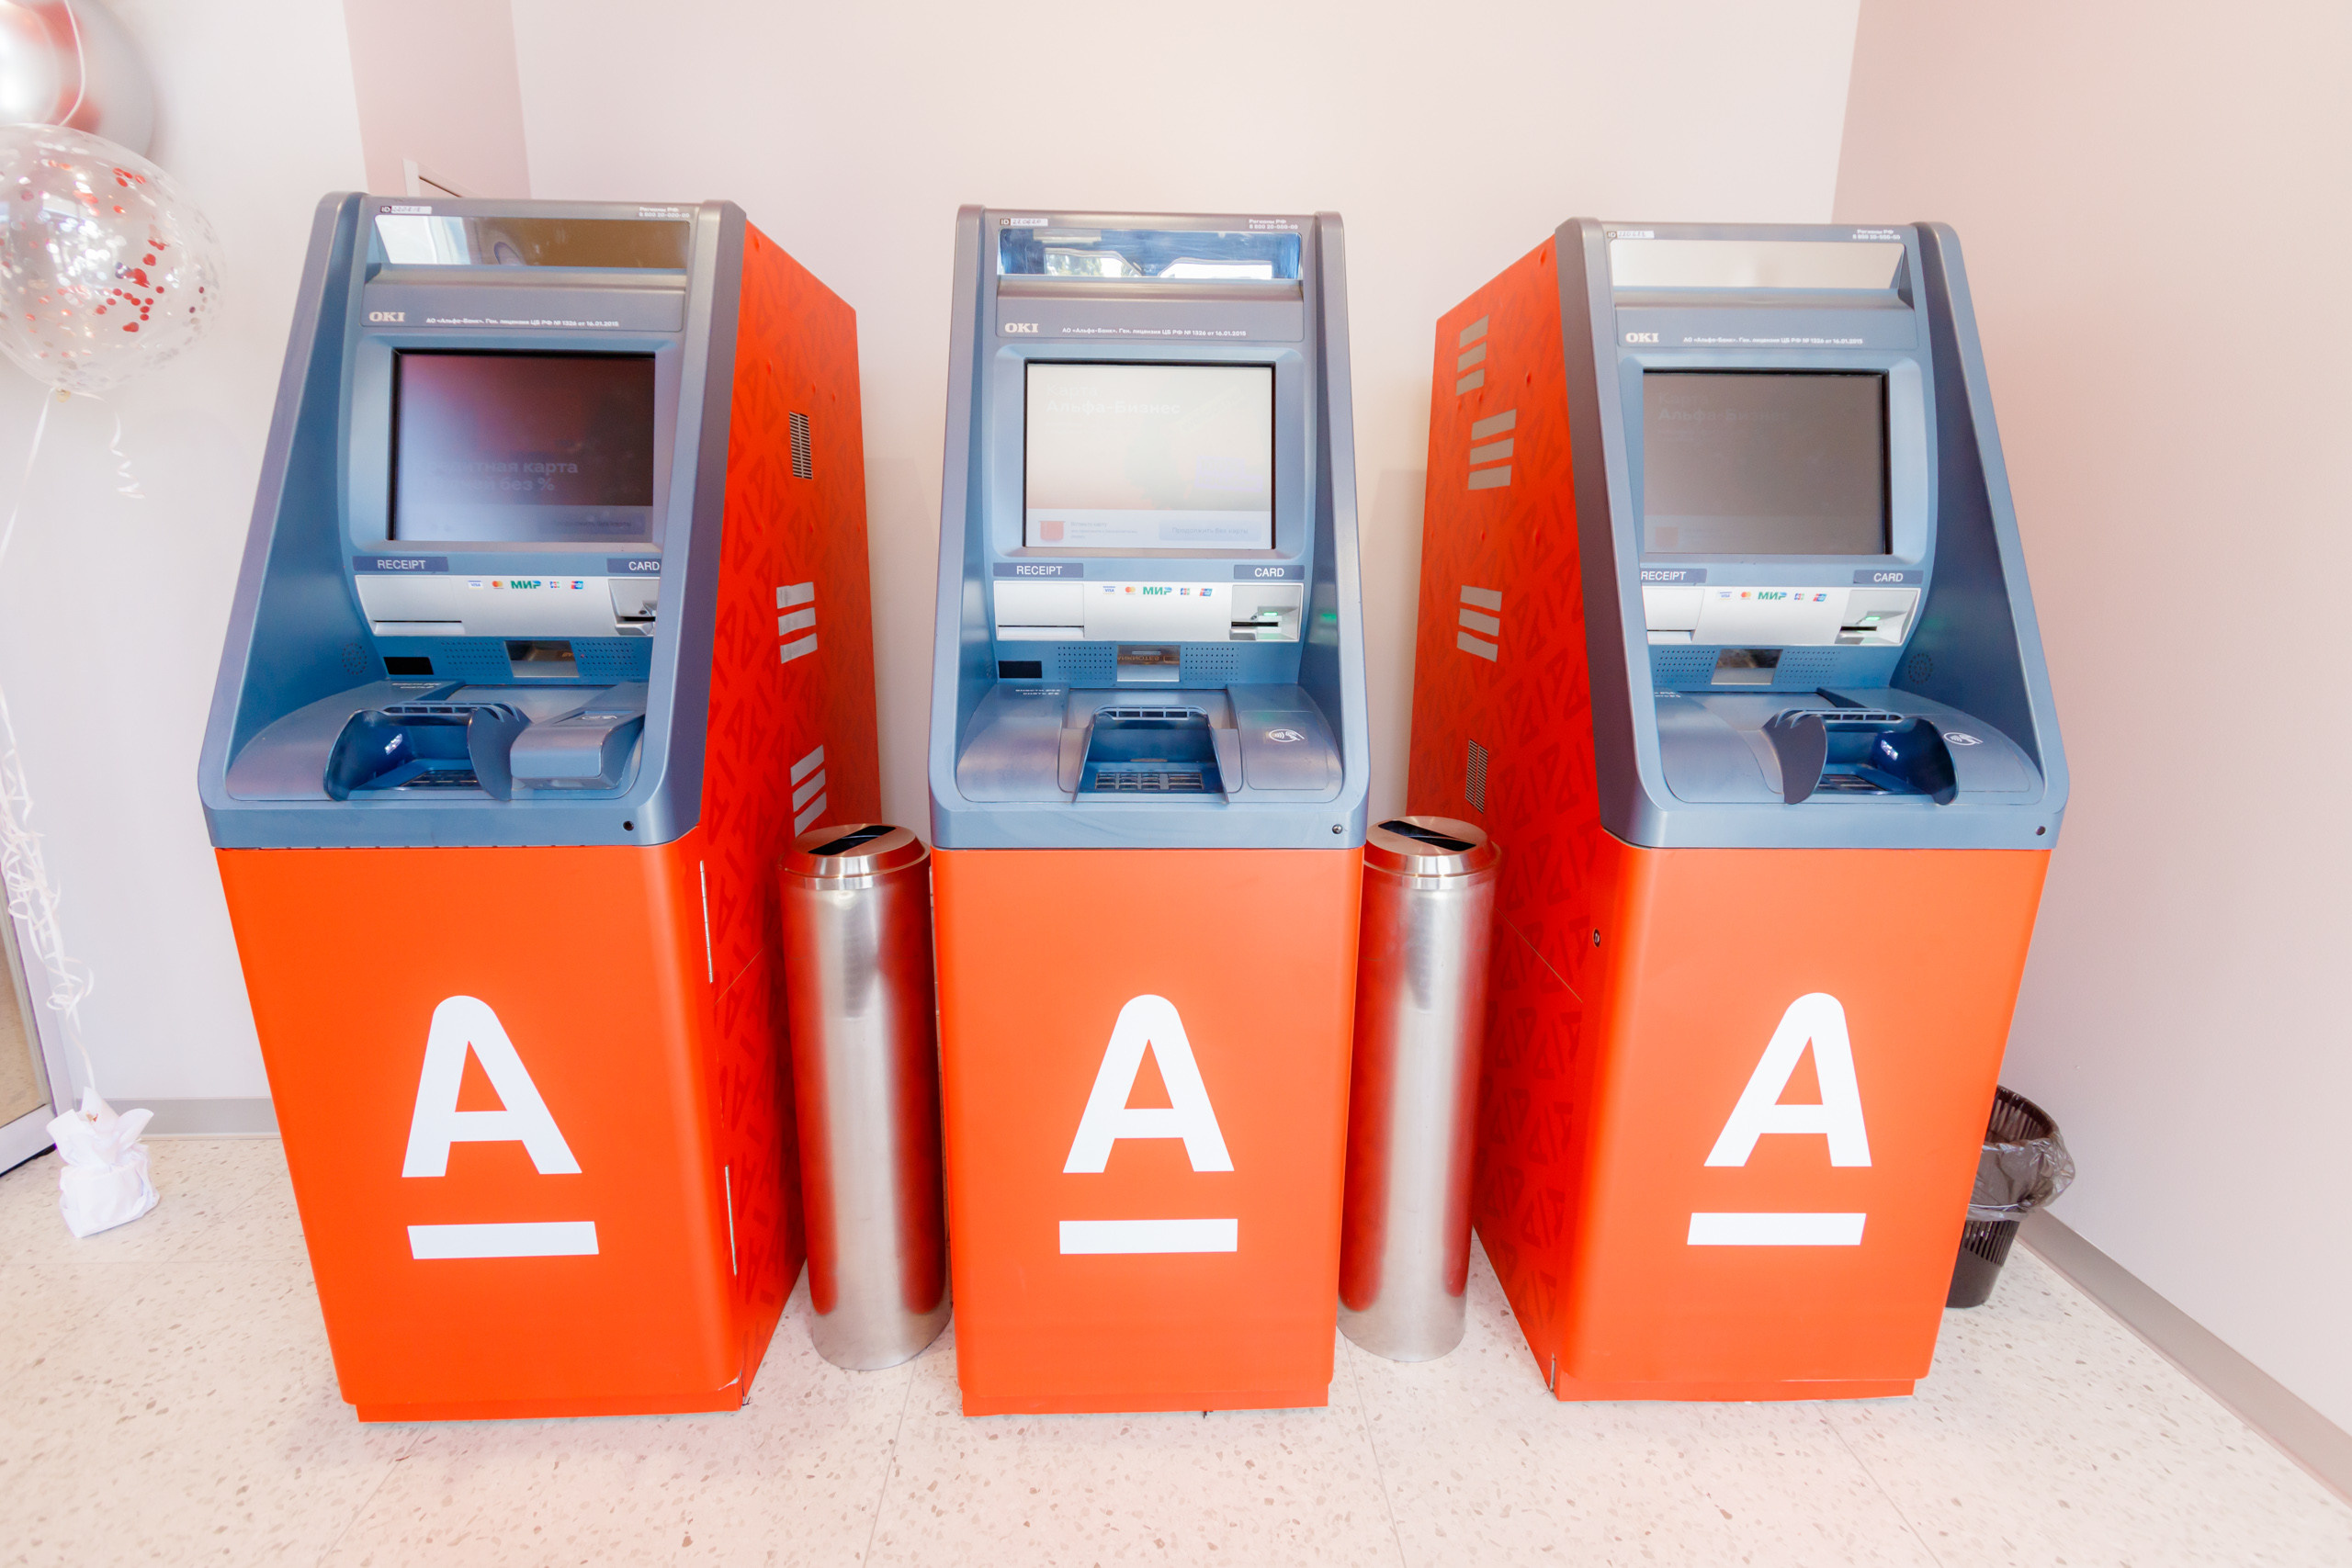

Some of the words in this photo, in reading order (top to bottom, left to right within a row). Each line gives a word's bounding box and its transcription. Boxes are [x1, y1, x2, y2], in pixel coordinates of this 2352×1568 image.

[368, 311, 405, 321] OKI
[1004, 322, 1039, 333] OKI
[1625, 333, 1659, 343] OKI
[1046, 400, 1182, 416] Альфа-Бизнес
[523, 462, 578, 477] карта
[500, 477, 533, 491] без
[537, 477, 556, 491] %
[1171, 526, 1214, 536] Продолжить
[1215, 526, 1227, 535] без
[1228, 527, 1249, 536] карты
[377, 559, 427, 570] RECEIPT
[628, 561, 661, 571] CARD
[1016, 565, 1063, 576] RECEIPT
[1254, 568, 1285, 578] CARD
[1640, 570, 1687, 581] RECEIPT
[1873, 572, 1904, 582] CARD
[511, 580, 542, 590] МИР
[1142, 586, 1172, 595] МИР
[1758, 591, 1788, 601] МИР
